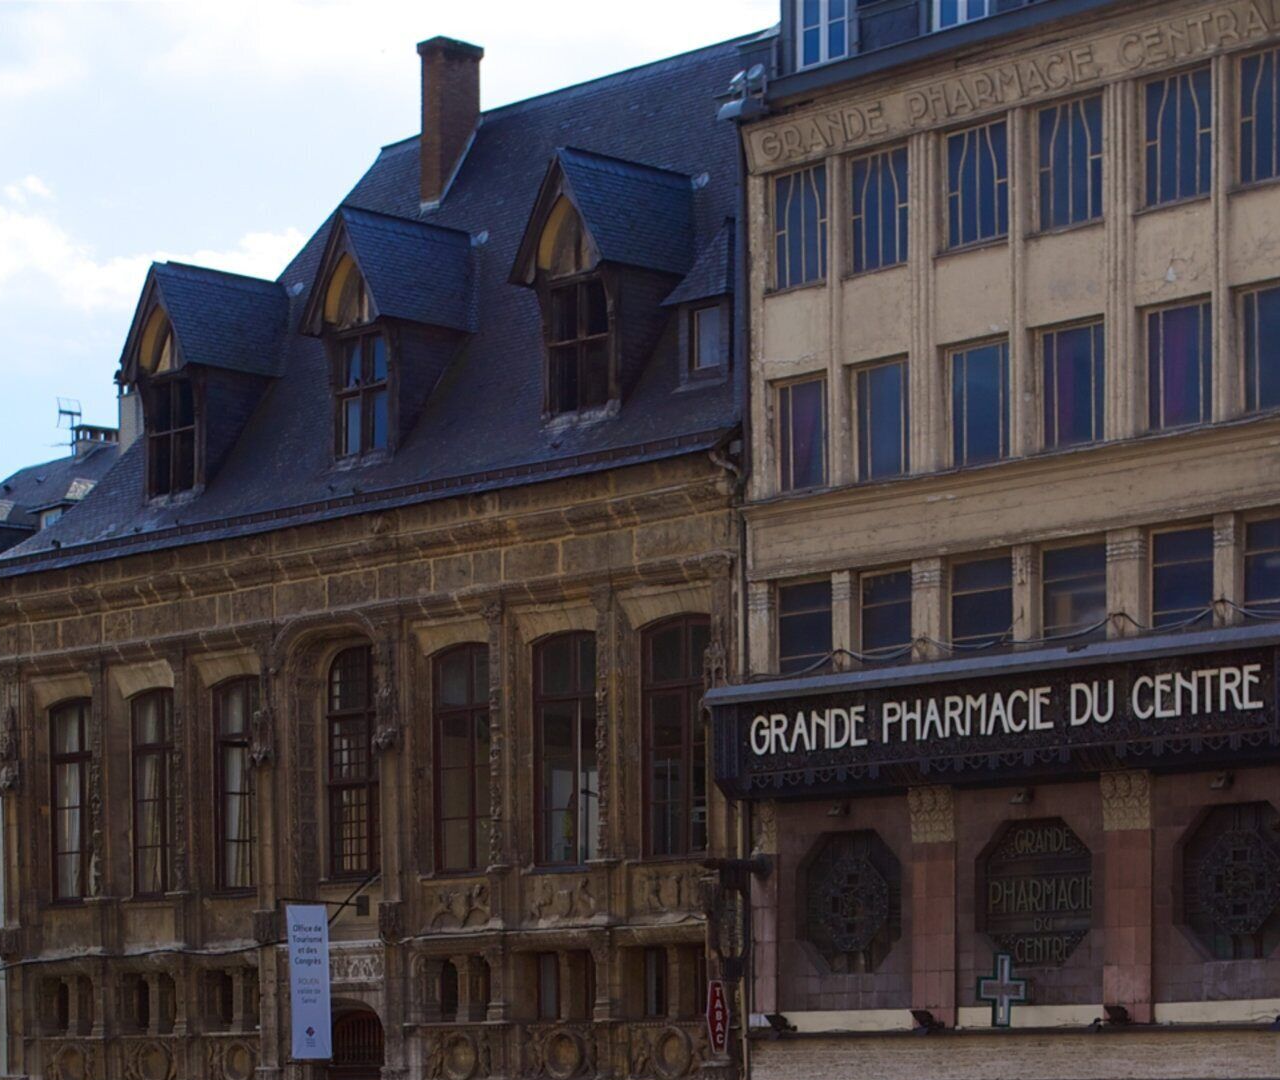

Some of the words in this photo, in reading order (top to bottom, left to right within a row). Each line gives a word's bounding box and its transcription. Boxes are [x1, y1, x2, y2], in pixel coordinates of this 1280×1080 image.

[761, 101, 890, 161] GRANDE
[750, 705, 868, 756] GRANDE
[882, 686, 1054, 744] PHARMACIE
[1070, 680, 1115, 726] DU
[1132, 664, 1264, 721] CENTRE
[1014, 828, 1070, 854] GRANDE
[1016, 936, 1070, 963] CENTRE
[714, 987, 724, 1044] TABAC
